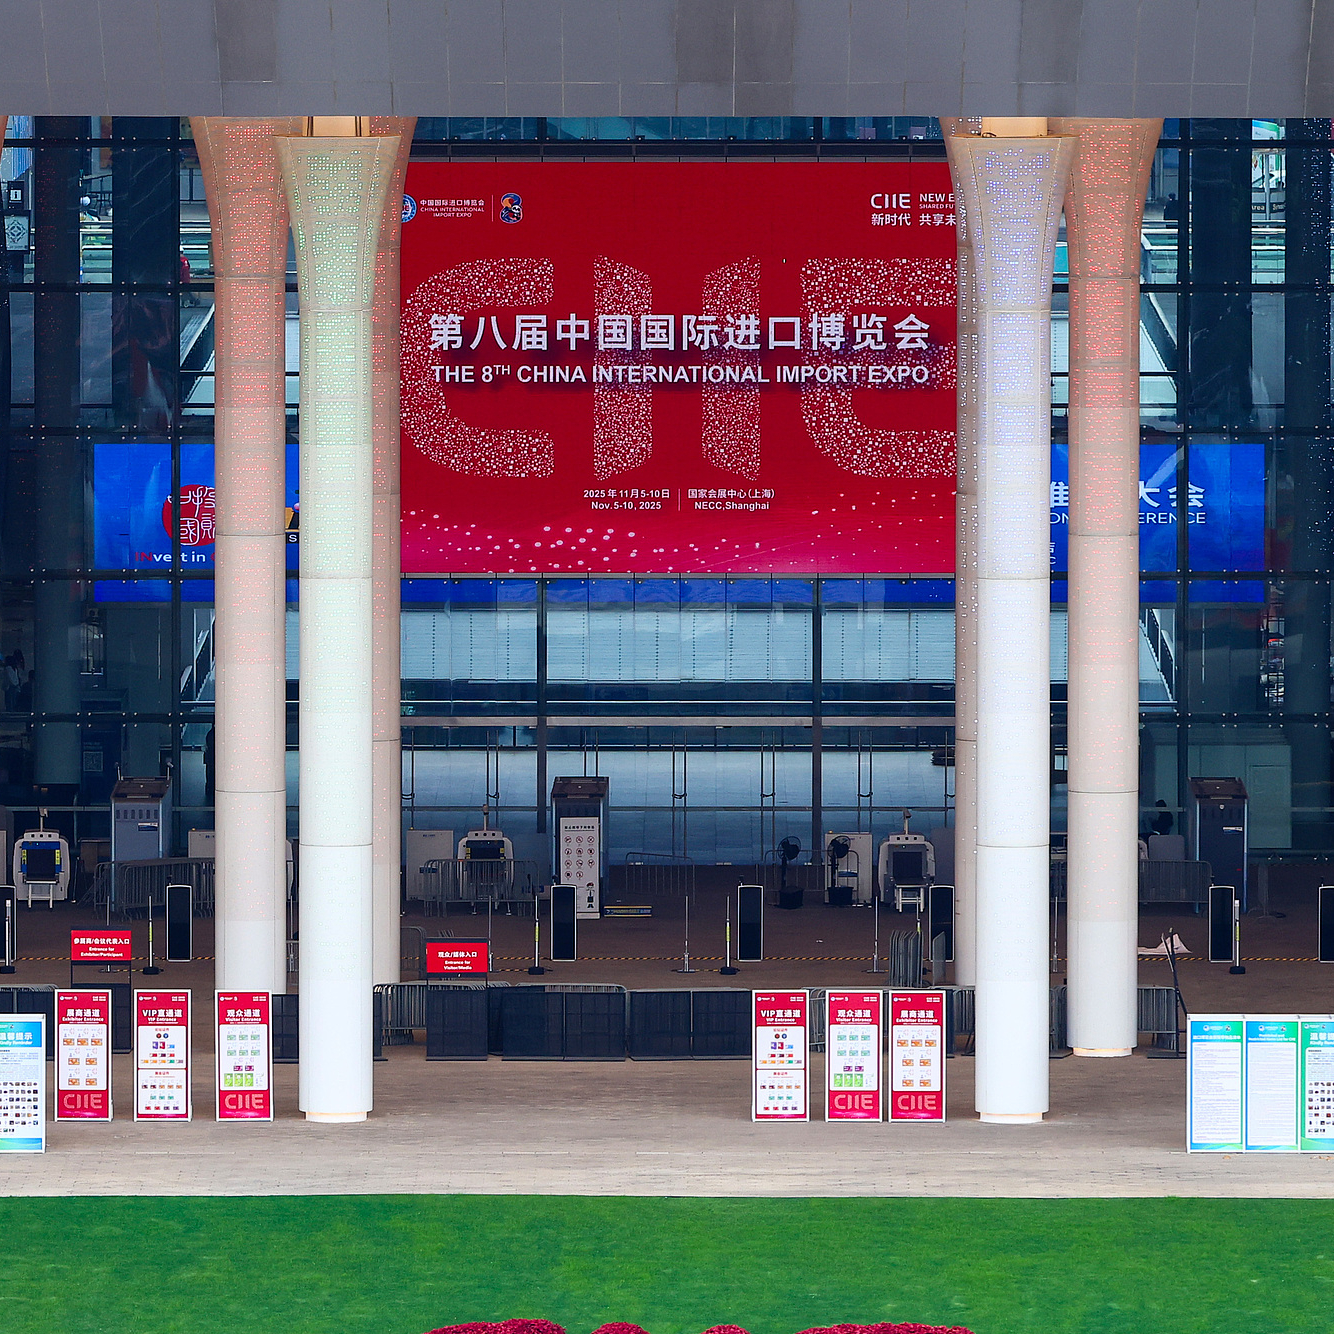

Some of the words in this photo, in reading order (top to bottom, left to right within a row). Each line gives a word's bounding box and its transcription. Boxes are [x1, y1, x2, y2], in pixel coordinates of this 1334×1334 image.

[420, 199, 485, 207] 中国国际进口博览会
[870, 193, 911, 209] CIIE
[919, 193, 946, 202] NEW
[871, 213, 911, 226] 新时代
[919, 213, 957, 226] 共享未
[428, 313, 931, 351] 第八届中国国际进口博览会
[432, 365, 475, 383] THE
[481, 364, 511, 383] 8TH
[517, 365, 587, 383] CHINA
[592, 365, 770, 383] INTERNATIONAL
[776, 365, 860, 383] IMPORT
[868, 365, 929, 383] EXPO
[639, 501, 662, 510] 2025
[135, 551, 188, 562] INvet
[191, 550, 206, 562] in
[63, 1093, 102, 1109] CIIE
[224, 1093, 265, 1110] CIIE
[833, 1094, 874, 1111] CIIE
[897, 1094, 937, 1111] CIIE
